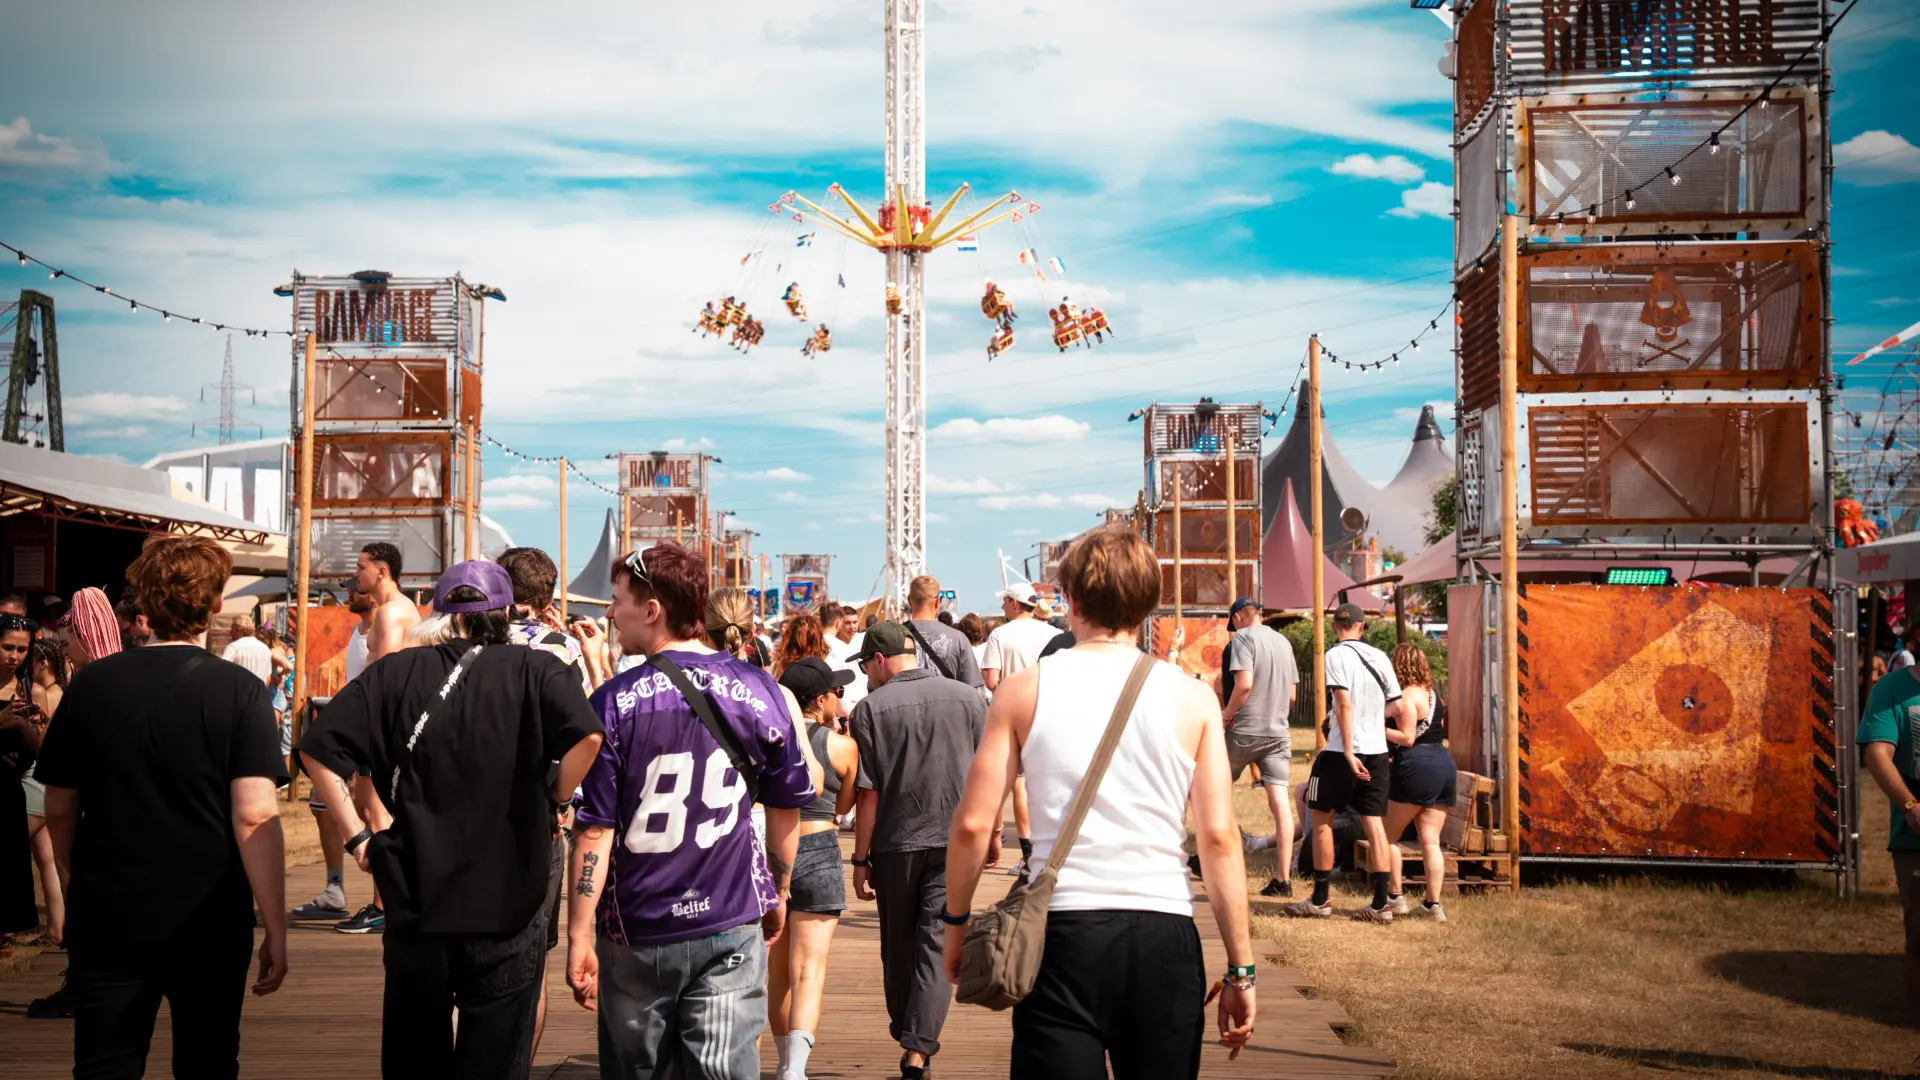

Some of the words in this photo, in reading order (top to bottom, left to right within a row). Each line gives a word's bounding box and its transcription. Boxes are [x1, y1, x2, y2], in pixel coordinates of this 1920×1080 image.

[315, 290, 437, 342] RAMPAGE
[629, 460, 691, 488] RAMPAGE
[624, 748, 748, 854] 89
[671, 896, 711, 917] Belief
